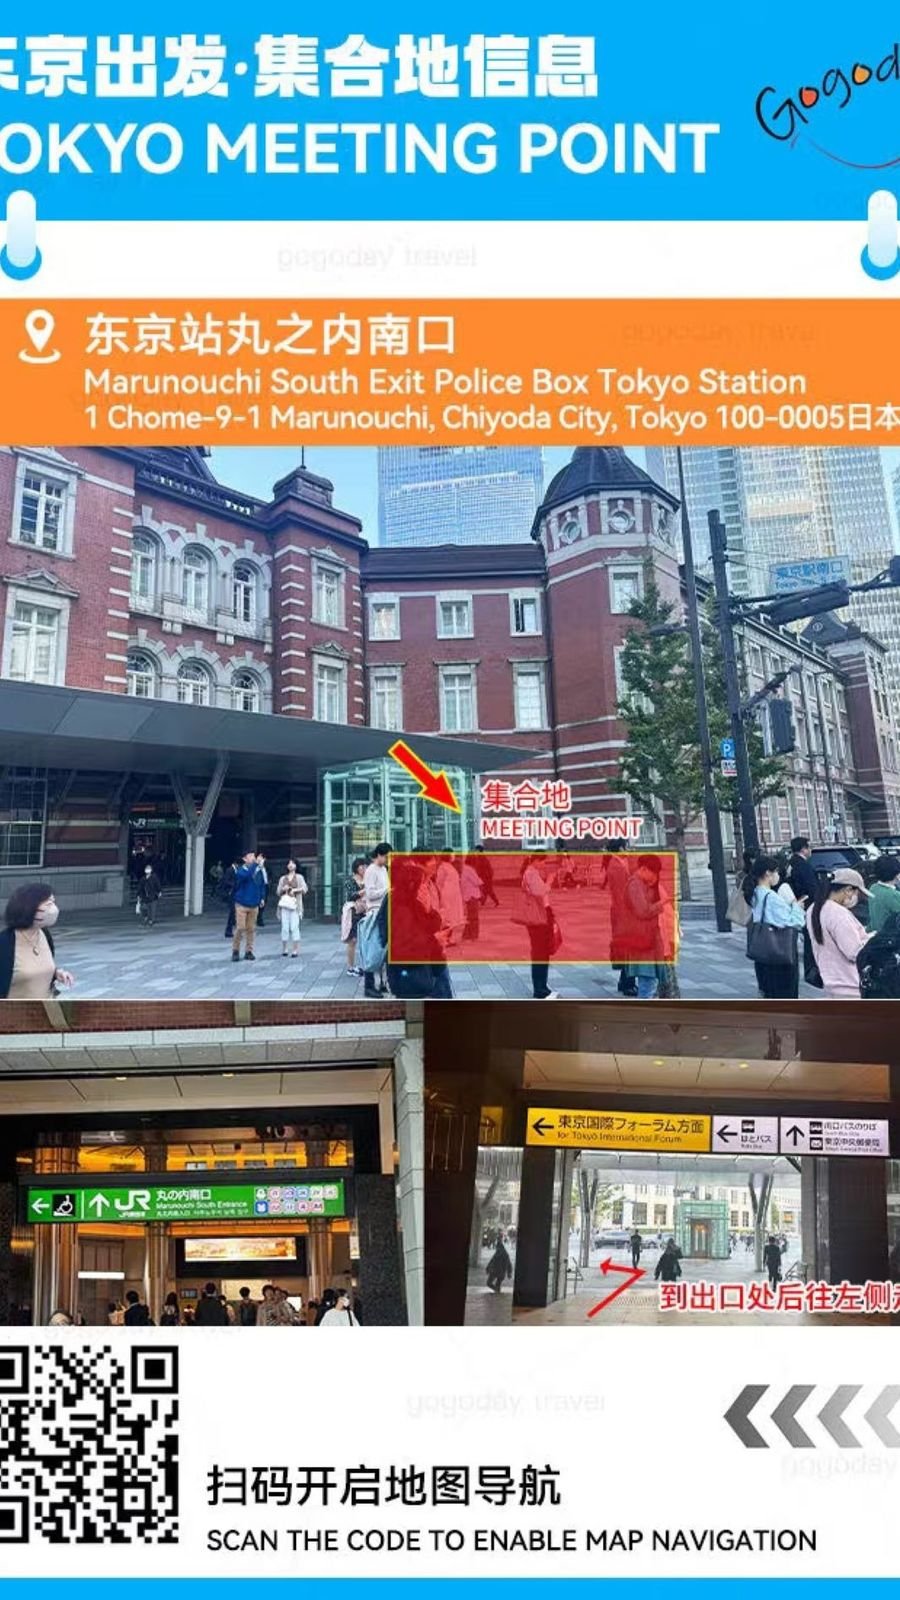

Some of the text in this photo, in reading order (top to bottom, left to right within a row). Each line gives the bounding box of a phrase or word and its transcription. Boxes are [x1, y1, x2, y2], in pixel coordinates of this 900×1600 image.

[558, 1114, 705, 1134] 東京国際フォーラム方面
[572, 1131, 598, 1141] Tokyo
[599, 1132, 652, 1143] International
[655, 1134, 683, 1143] Forum
[114, 1189, 152, 1211] JR
[156, 1188, 212, 1201] 丸の内南口
